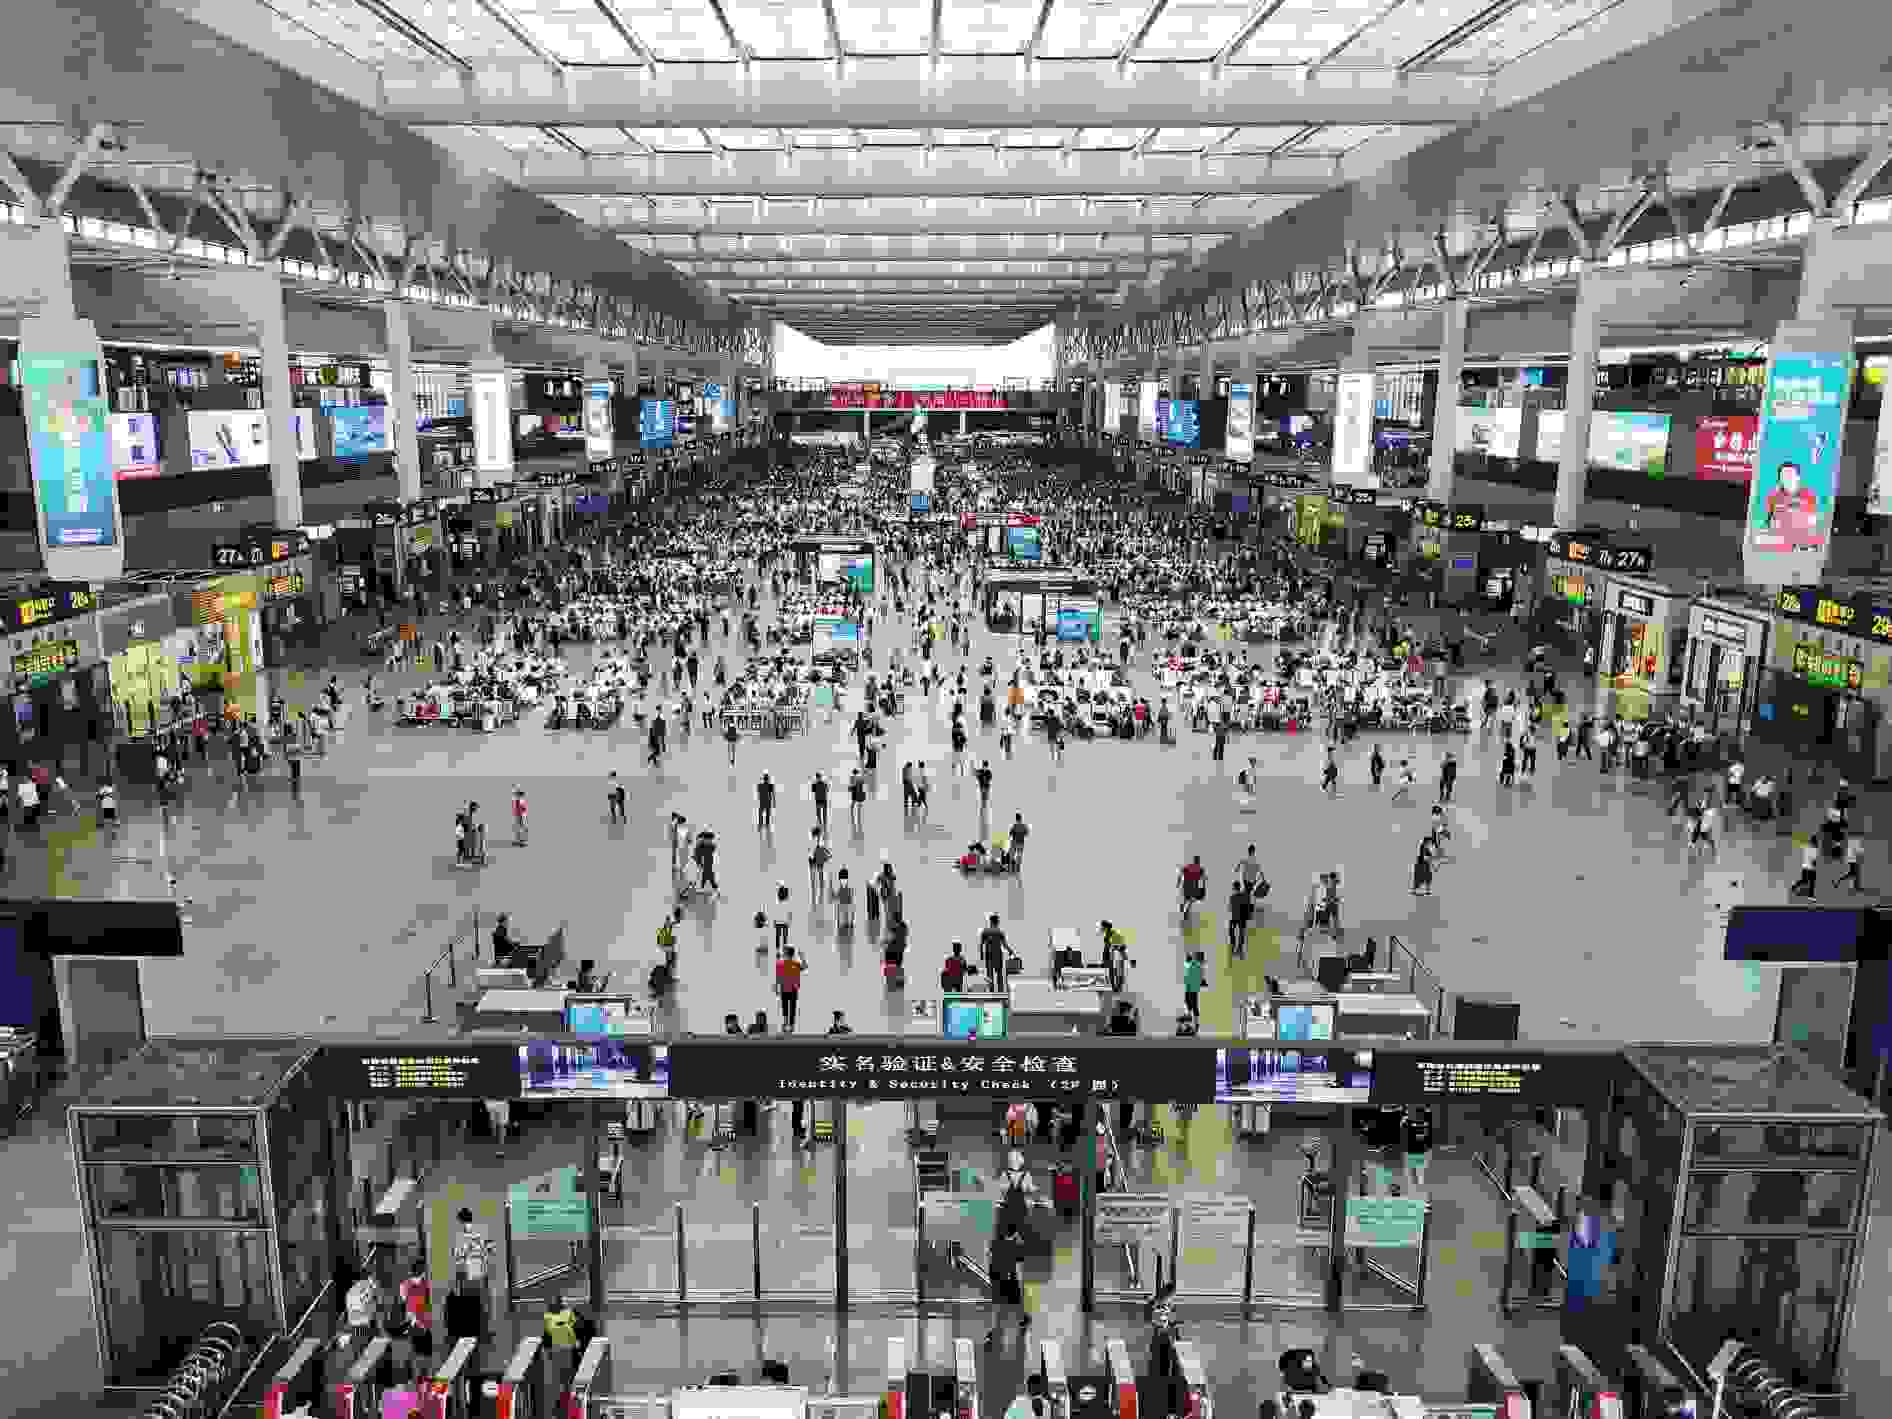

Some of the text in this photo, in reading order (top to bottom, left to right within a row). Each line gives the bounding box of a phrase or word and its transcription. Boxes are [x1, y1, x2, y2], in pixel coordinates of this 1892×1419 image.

[818, 1055, 1078, 1073] 实名验证&安全检查
[777, 1079, 857, 1090] Identity
[888, 1079, 969, 1091] Security
[980, 1079, 1032, 1089] Check
